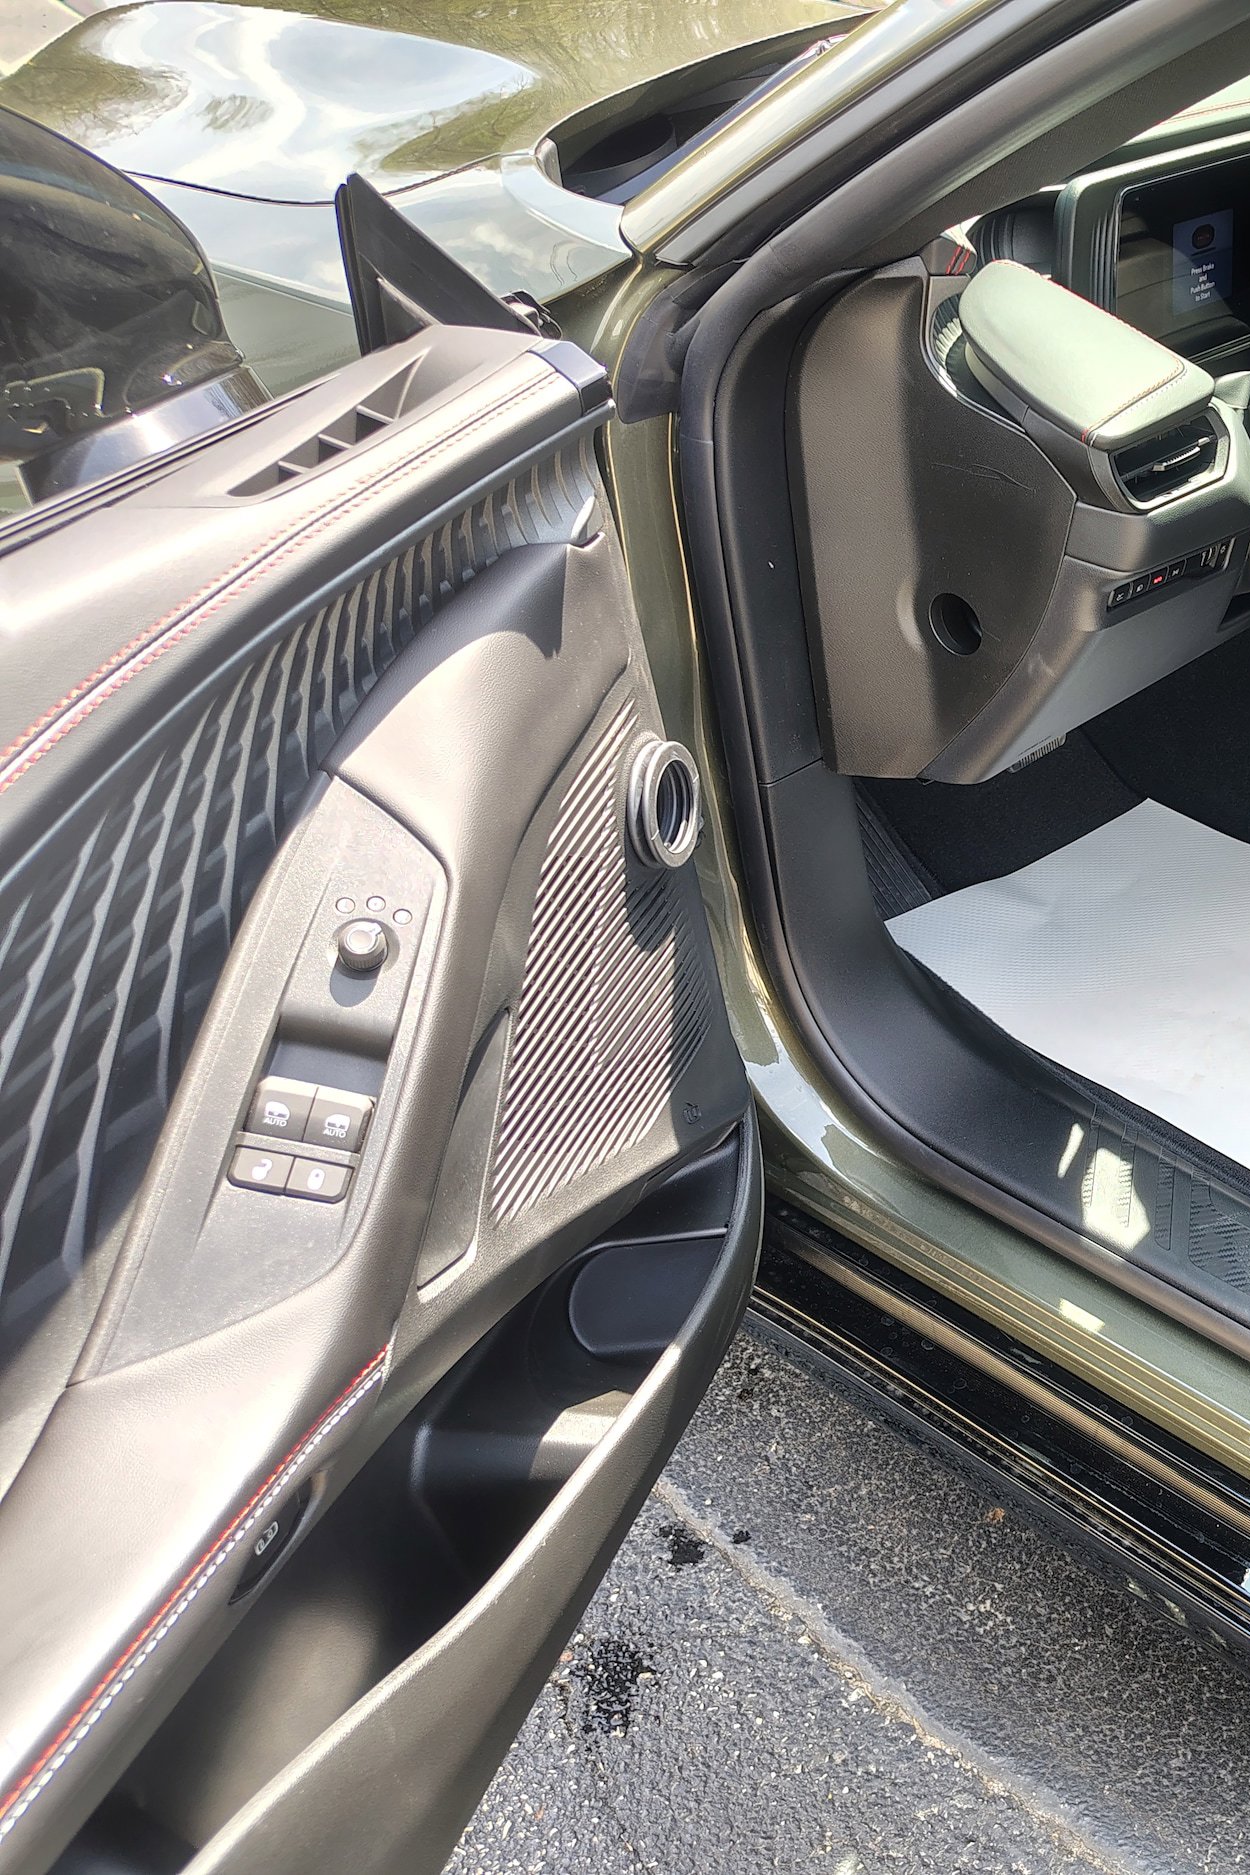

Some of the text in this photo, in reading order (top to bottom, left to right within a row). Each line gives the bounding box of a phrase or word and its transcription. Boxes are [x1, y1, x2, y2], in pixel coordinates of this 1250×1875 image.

[1191, 263, 1215, 276] Press Brake
[1199, 274, 1207, 282] and
[1190, 281, 1215, 295] Push Button
[1200, 291, 1211, 300] Start
[263, 1117, 287, 1127] AUTO
[323, 1128, 346, 1138] AUTO
